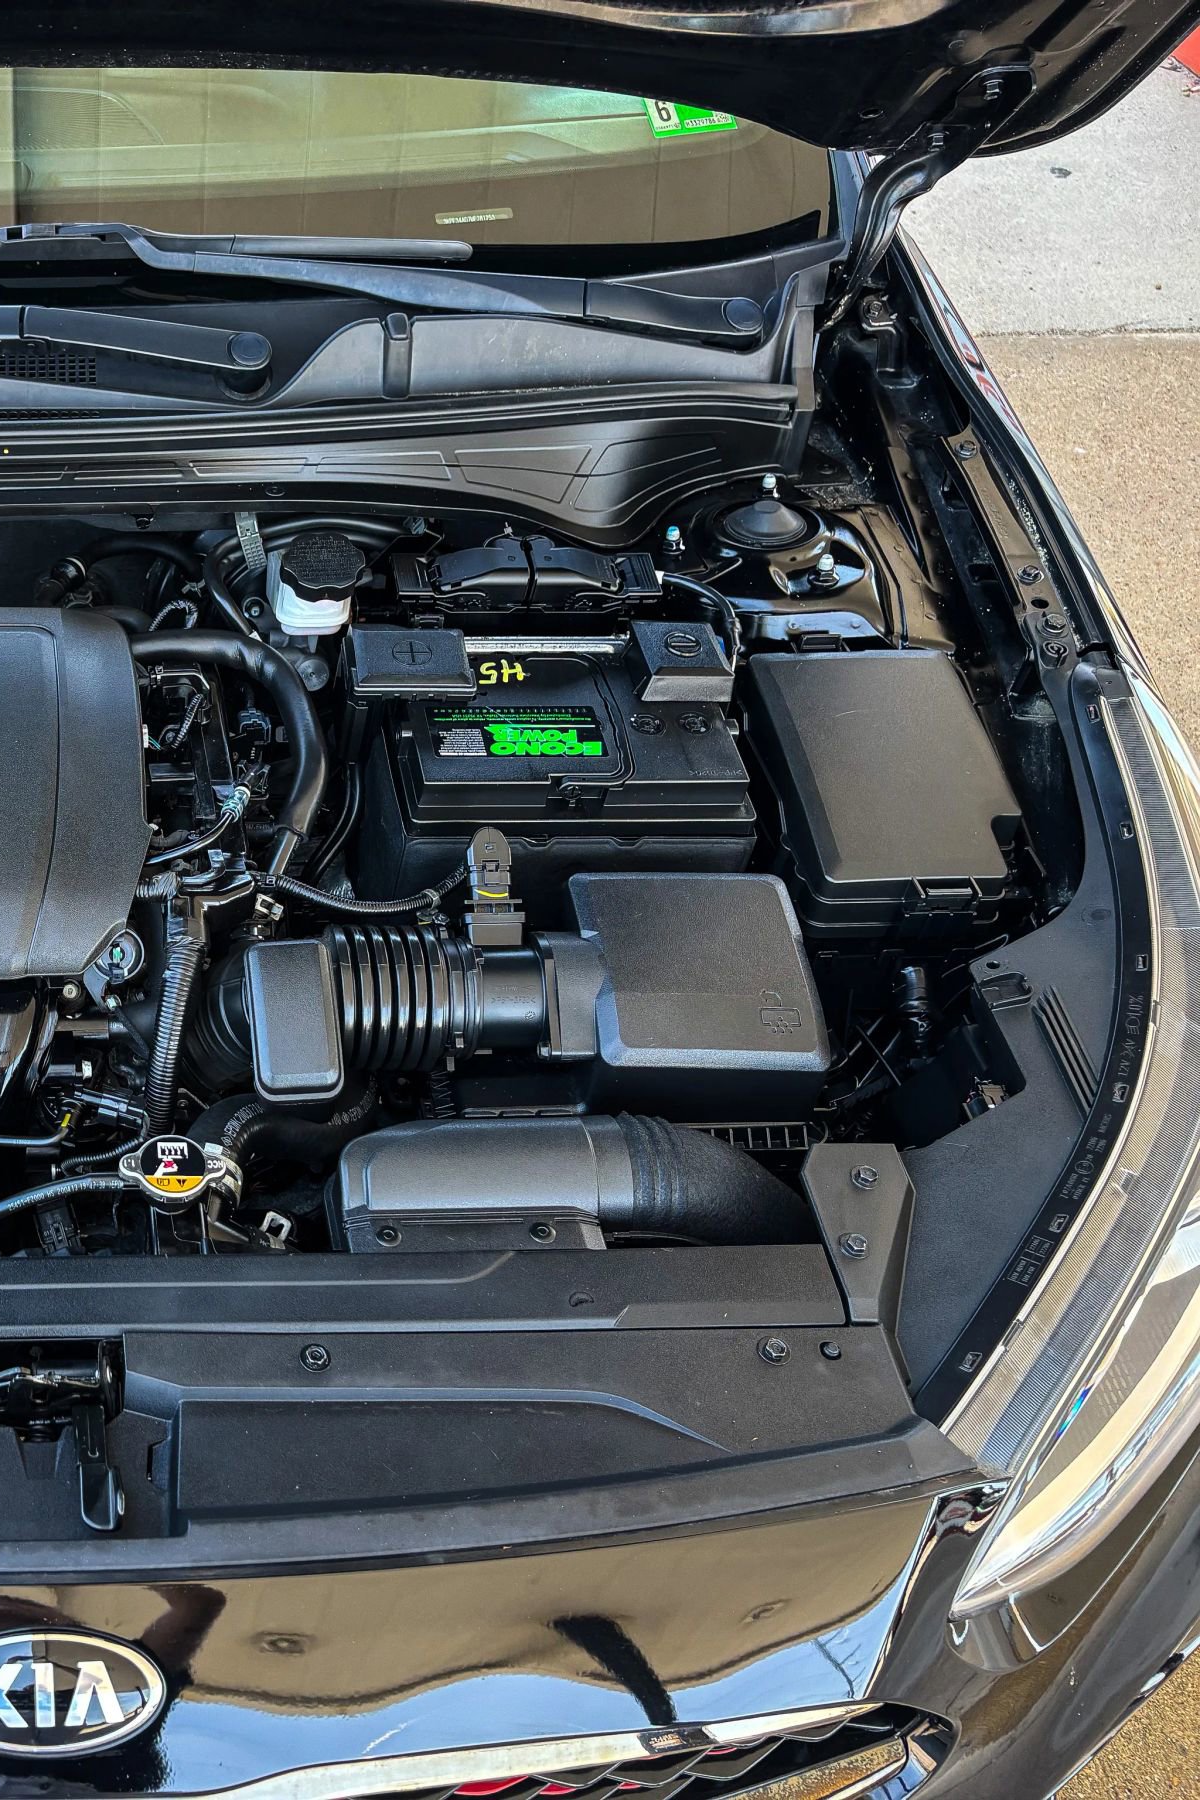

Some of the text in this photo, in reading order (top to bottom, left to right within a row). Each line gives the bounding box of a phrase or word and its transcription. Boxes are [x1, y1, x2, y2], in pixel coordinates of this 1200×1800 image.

[655, 100, 672, 122] 6
[486, 727, 578, 742] POWER
[490, 741, 602, 756] ECONO
